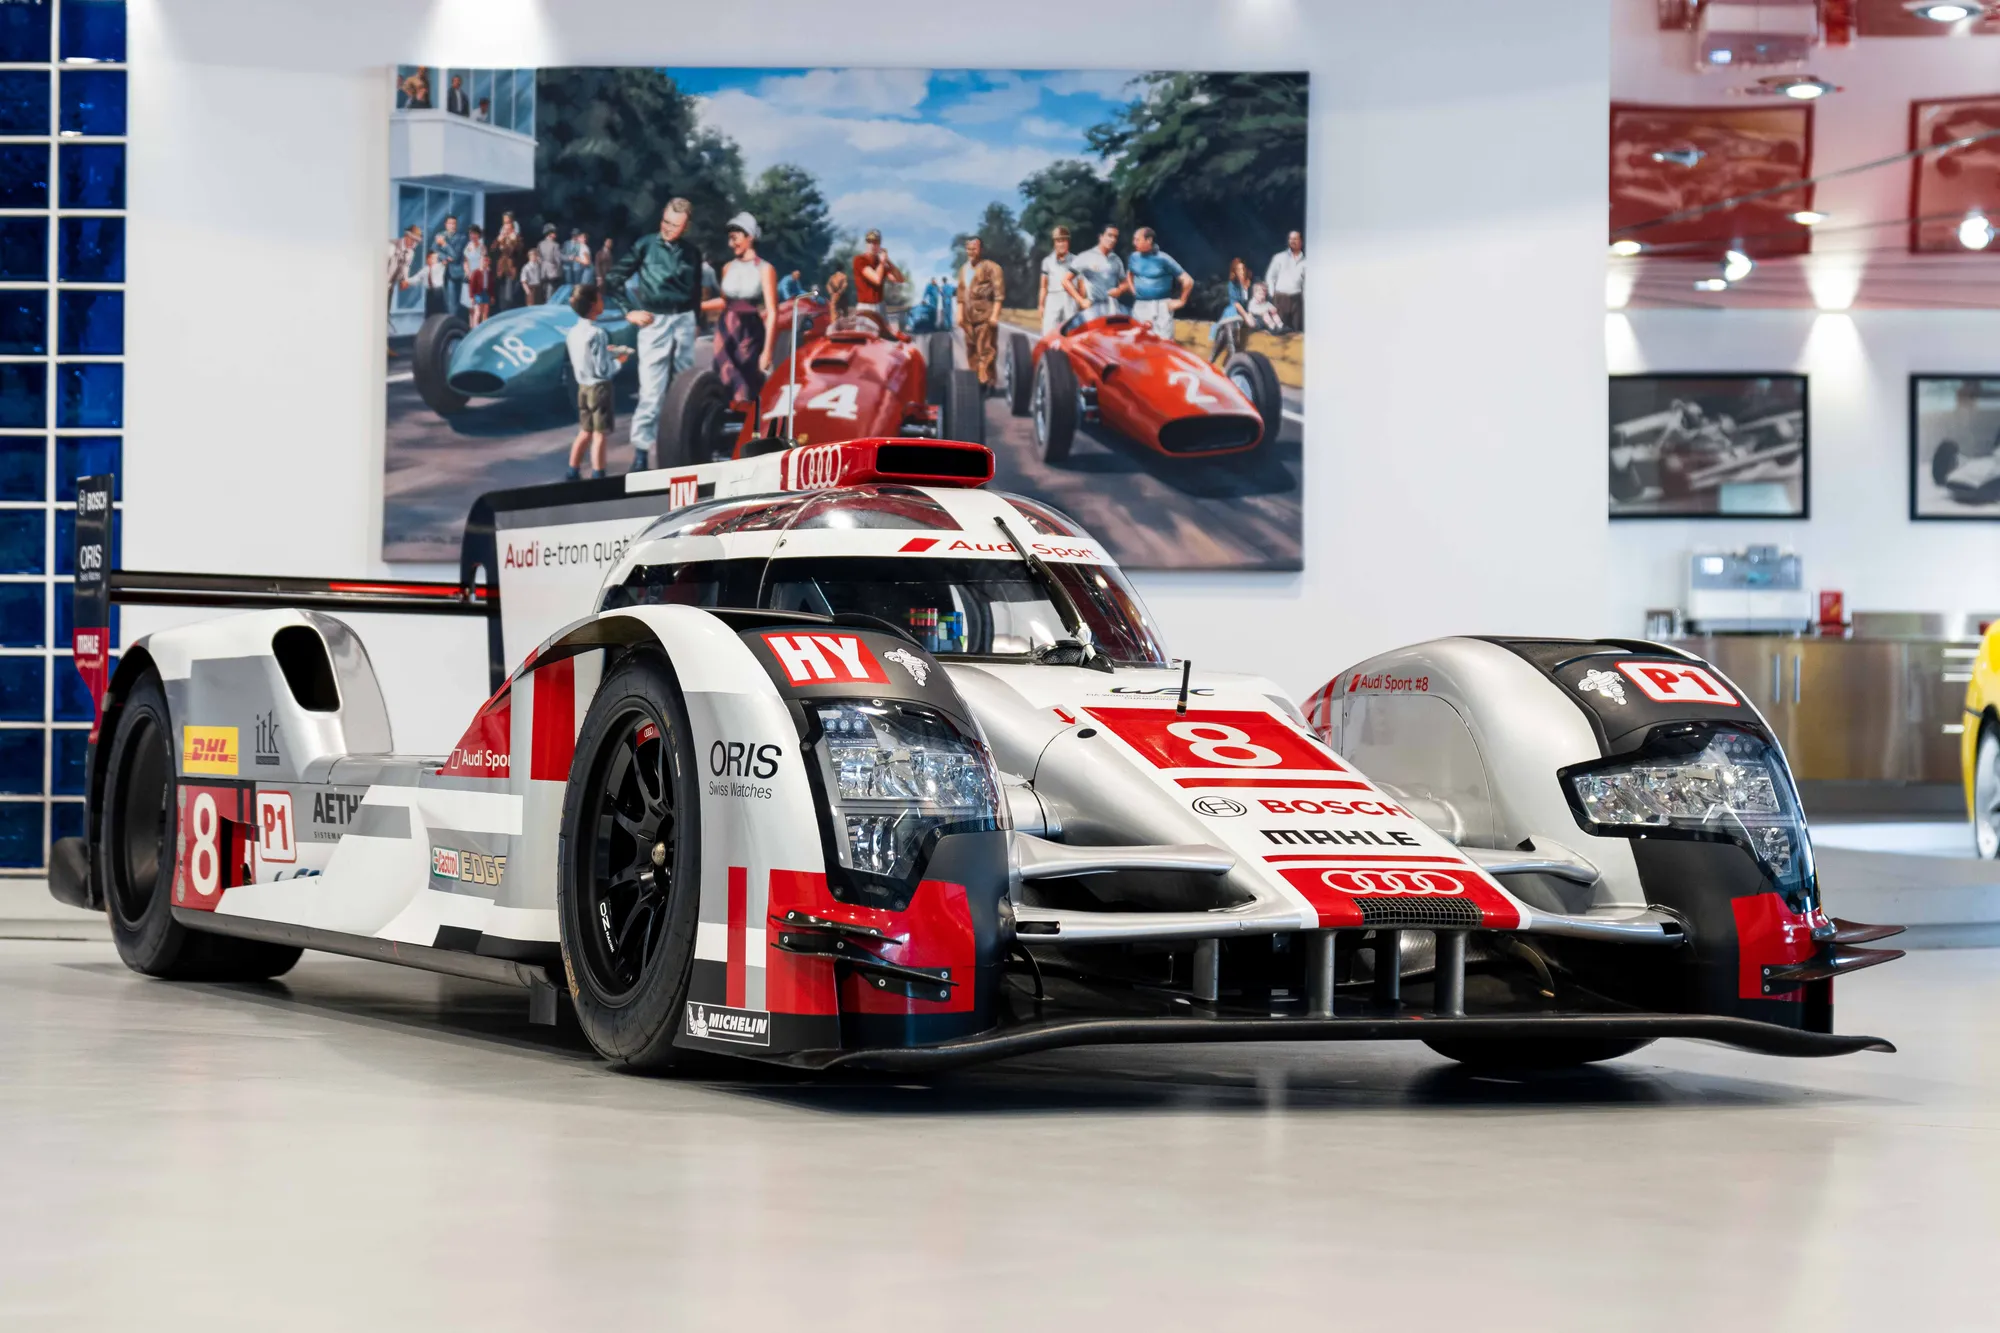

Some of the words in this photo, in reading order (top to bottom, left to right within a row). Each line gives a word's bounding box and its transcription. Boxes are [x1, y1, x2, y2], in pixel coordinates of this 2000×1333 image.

[492, 336, 538, 367] 18
[1168, 372, 1218, 403] 2
[762, 383, 860, 420] 14
[87, 491, 108, 511] BOSCH
[79, 544, 102, 570] ORIS
[504, 541, 539, 569] Audi
[543, 537, 589, 566] e-tron
[593, 534, 633, 568] quat
[948, 540, 1017, 553] Aud
[1031, 543, 1101, 560] Sport
[76, 634, 100, 654] MAHLE
[767, 635, 870, 681] HY
[1360, 674, 1383, 689] Audi
[1384, 674, 1413, 693] Sport
[1415, 676, 1429, 692] #8
[1638, 667, 1720, 696] P1
[255, 710, 280, 754] itk
[1166, 721, 1282, 767] 8
[191, 738, 229, 762] DHL
[461, 749, 483, 767] Audi
[709, 740, 783, 779] ORIS
[709, 780, 729, 797] Swiss
[730, 781, 772, 799] Watches
[313, 792, 365, 825] AETH
[1256, 799, 1415, 820] BOSCH
[263, 804, 289, 850] P1
[314, 831, 343, 840] SISTEMA
[1259, 829, 1422, 847] MAHLE
[191, 792, 219, 895] 8
[438, 850, 458, 875] Castrol
[708, 1012, 768, 1034] MICHELIN
